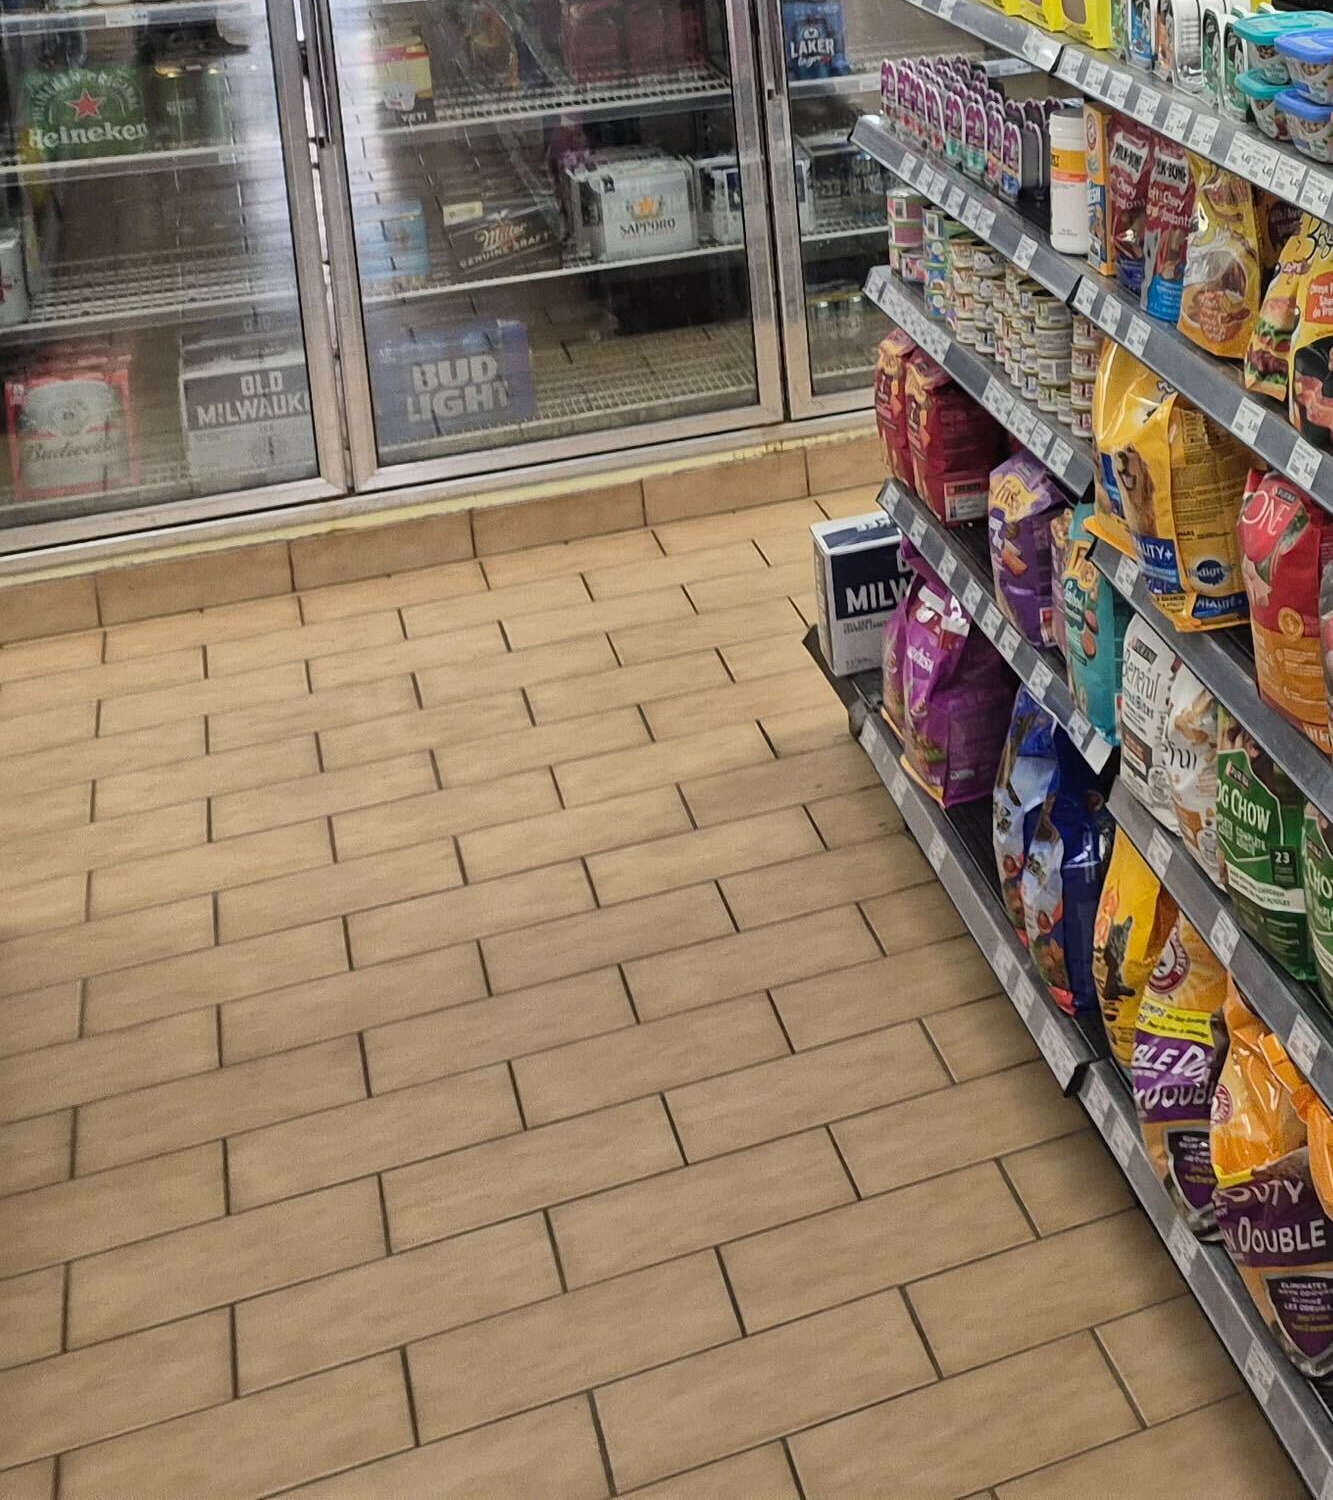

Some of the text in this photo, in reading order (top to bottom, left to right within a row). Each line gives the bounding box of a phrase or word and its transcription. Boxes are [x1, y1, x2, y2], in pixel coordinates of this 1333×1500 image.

[28, 120, 149, 153] Heineken
[618, 216, 677, 238] SAPPORO
[240, 371, 284, 397] OLD
[411, 354, 499, 389] BUD
[406, 383, 509, 422] LIGHT
[1230, 792, 1272, 836] CHOW
